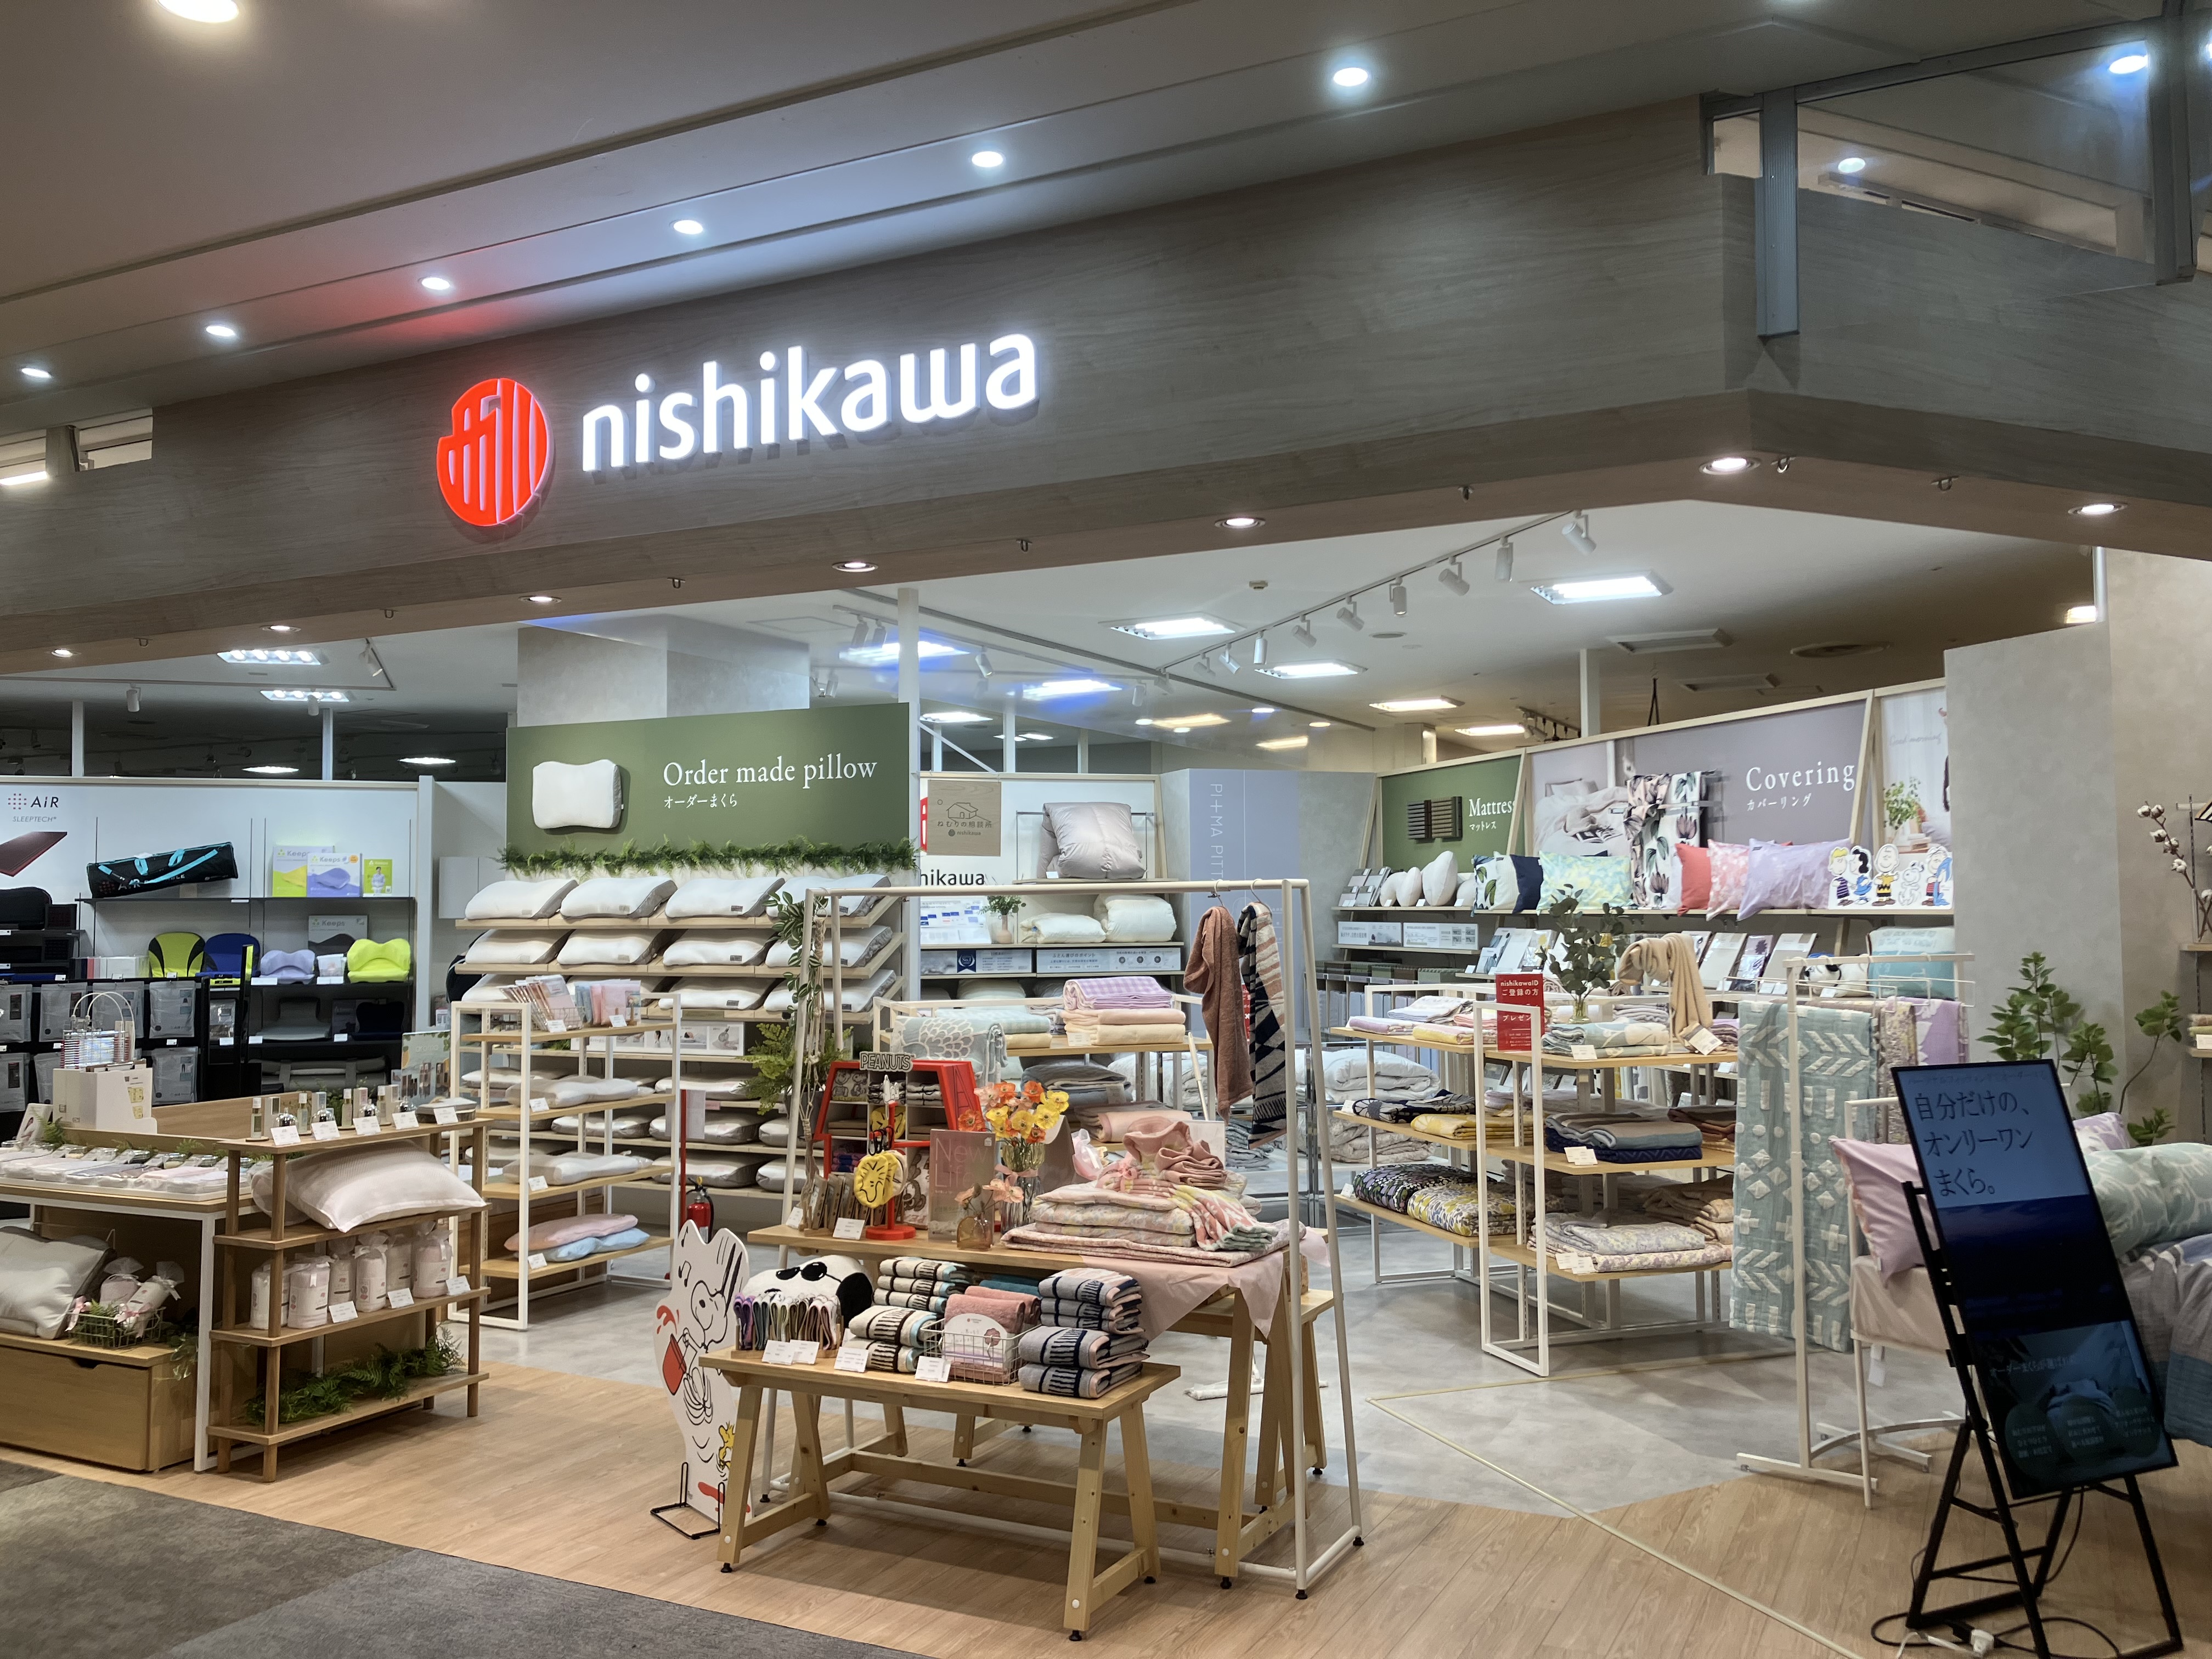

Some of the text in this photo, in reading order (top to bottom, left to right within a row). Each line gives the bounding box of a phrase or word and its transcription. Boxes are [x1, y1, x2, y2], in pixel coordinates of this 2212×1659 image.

[583, 332, 1037, 472] nishikawa
[663, 753, 877, 789] Order made pillow
[1746, 761, 1855, 792] Covering
[664, 793, 737, 809] オーダーまくら
[1747, 793, 1812, 811] カバーリング
[1469, 821, 1497, 832] マットレス
[1210, 845, 1224, 881] PITT
[860, 1053, 911, 1070] PEANUTS
[1915, 1091, 2030, 1121] 自分だけの、
[936, 1138, 987, 1163] New
[1923, 1128, 2033, 1156] オンリーワン
[935, 1163, 975, 1188] Life
[1934, 1167, 1996, 1198] まくら。
